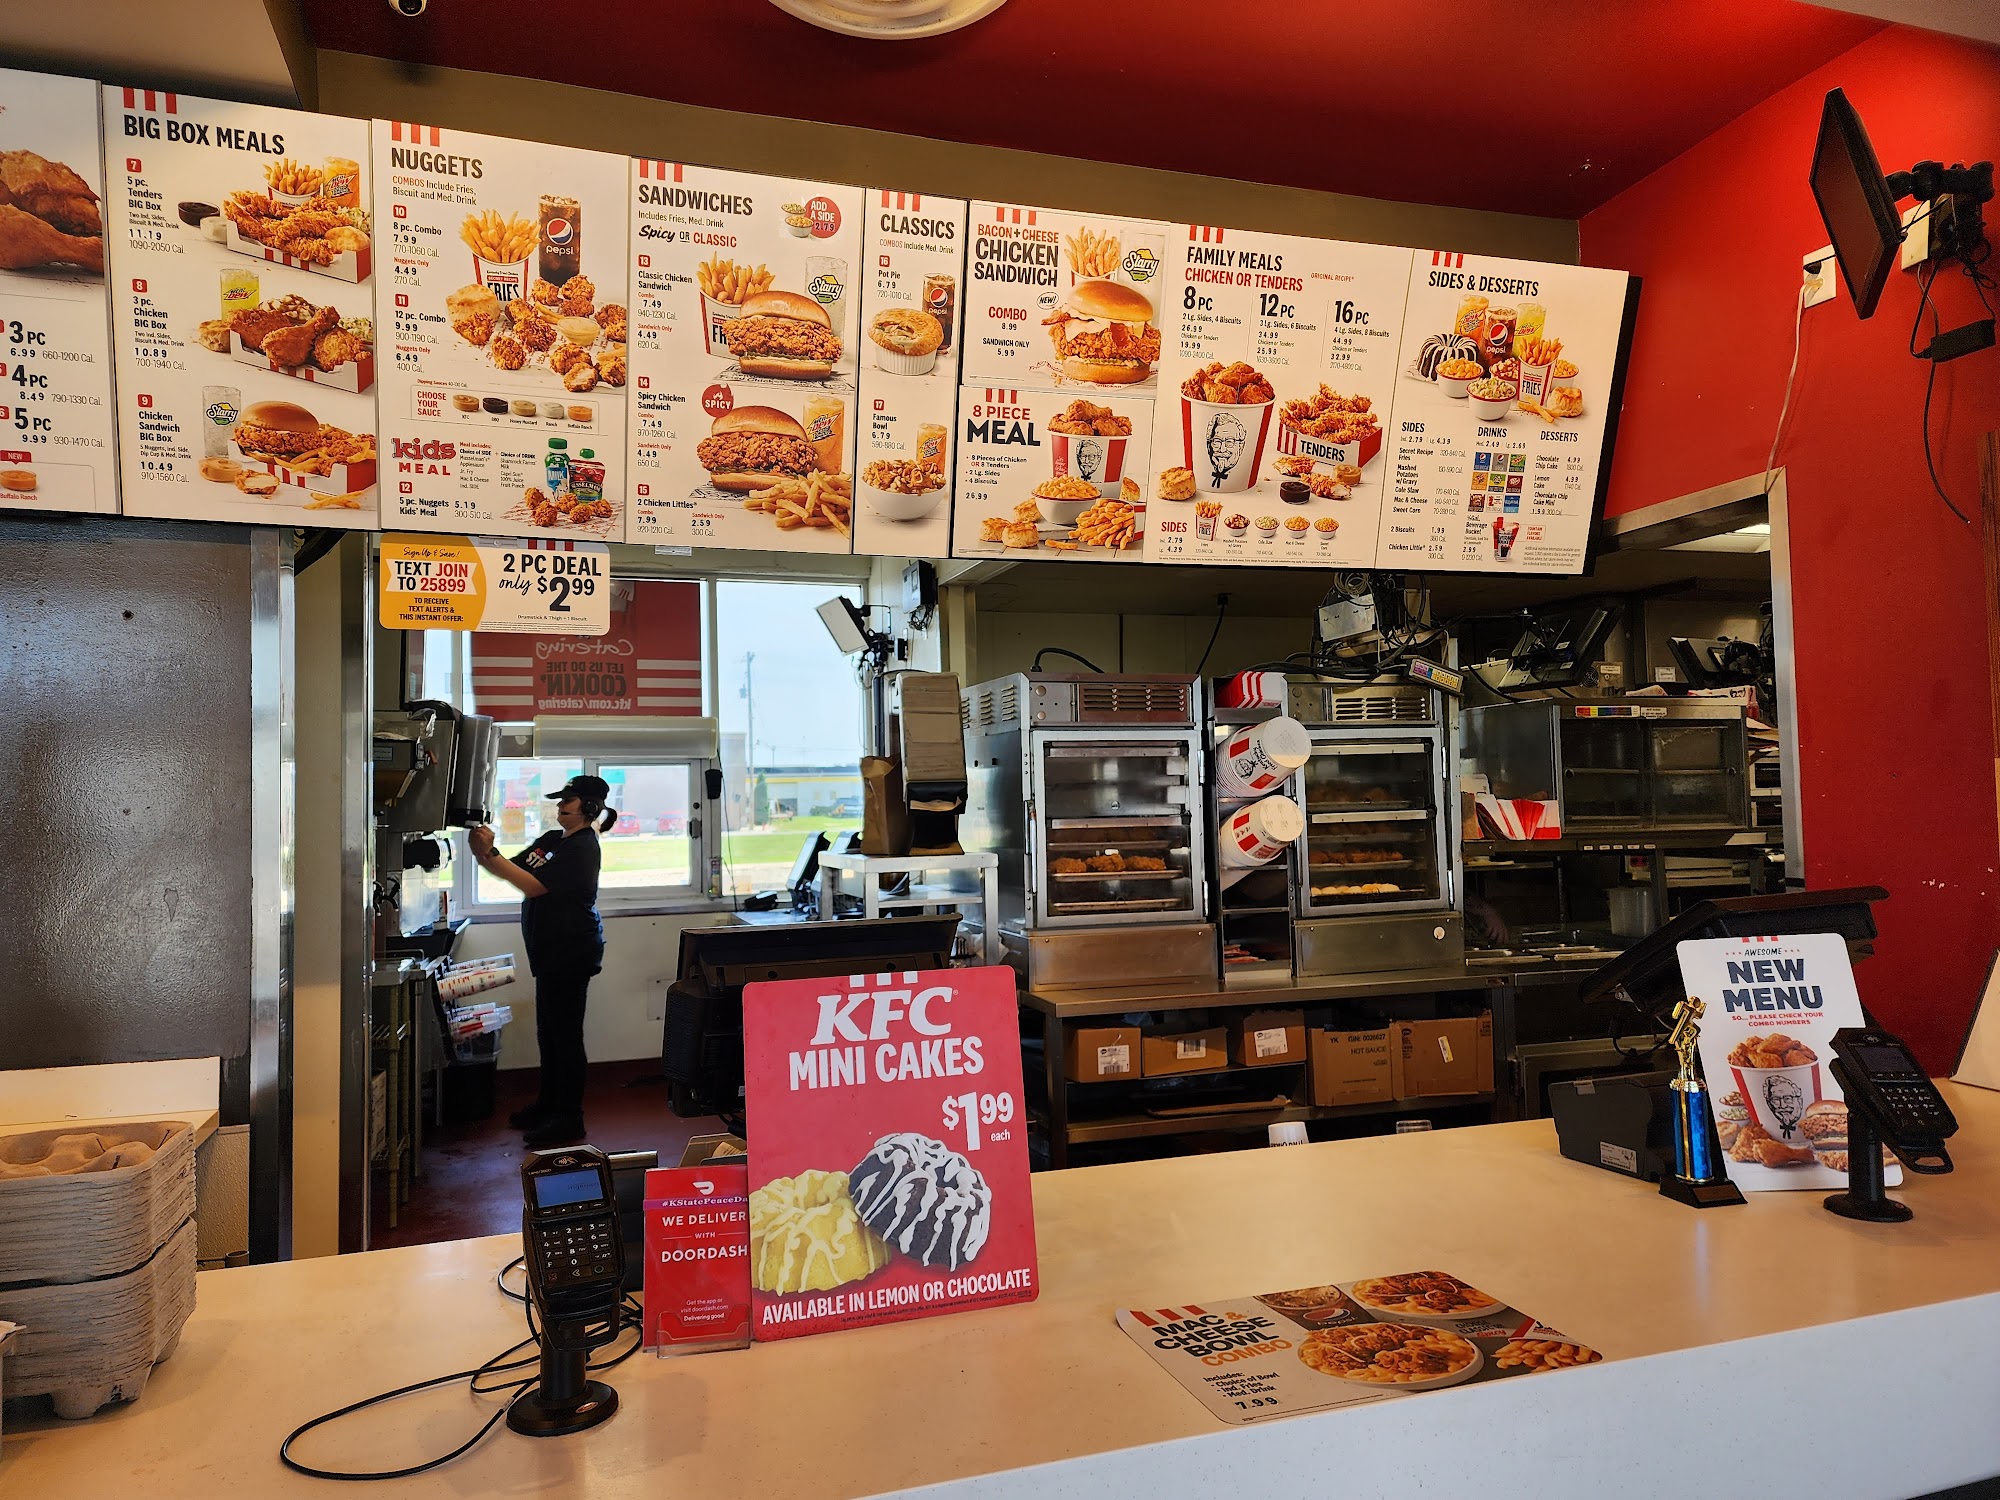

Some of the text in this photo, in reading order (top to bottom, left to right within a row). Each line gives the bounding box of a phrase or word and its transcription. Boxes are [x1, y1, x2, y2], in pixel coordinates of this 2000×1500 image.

[123, 114, 285, 155] BIG BOX MEALS
[391, 147, 483, 179] NUGGETS
[128, 176, 148, 188] 5 pc.
[392, 176, 476, 195] COMBOS Include Fries,
[128, 188, 163, 200] Tenders
[639, 184, 753, 216] SANDWICHES
[129, 200, 162, 211] BIG Box
[811, 201, 827, 212] ADD
[638, 211, 724, 228] Includes Fries, Med. Drink
[811, 211, 835, 223] A SIDE
[393, 222, 441, 235] 8 pc. Combo
[815, 223, 835, 231] 2.79
[880, 213, 954, 240] CLASSICS
[978, 224, 1012, 238] BACON
[1023, 229, 1059, 243] CHEESE
[129, 229, 162, 240] 11.19
[394, 234, 417, 244] 7.99
[639, 225, 737, 248] Spicy OR CLASSIC
[546, 245, 573, 256] pepsi
[976, 238, 1059, 267] CHICKEN
[1123, 253, 1160, 276] Starry
[1187, 246, 1282, 271] FAMILY MEALS
[638, 271, 693, 284] Classic Chicken
[878, 270, 900, 279] Pot Pie
[975, 262, 1057, 287] SANDWICH
[1185, 267, 1303, 291] CHICKEN OR TENDERS
[638, 281, 672, 291] Sandwich
[878, 281, 896, 289] 6.79
[1429, 270, 1539, 296] SIDES & DESSERTS
[644, 300, 661, 308] 7.49
[1039, 296, 1056, 305] NEW!
[1184, 286, 1213, 311] 8 PC
[1260, 293, 1295, 318] 12 PC
[988, 306, 1027, 321] COMBO
[1335, 300, 1369, 325] 16 PC
[9, 321, 46, 345] 3 PC
[983, 337, 1029, 348] SANDWICH ONLY
[10, 348, 36, 358] 6.99
[998, 348, 1015, 356] 5.99
[12, 365, 48, 388] 4 PC
[20, 391, 45, 401] 8.49
[417, 391, 446, 400] CHOOSE
[638, 392, 685, 402] Spicy Chicken
[417, 400, 437, 408] YOUR
[638, 401, 671, 411] Sandwich
[705, 399, 731, 409] SPICY
[15, 408, 51, 431] 5 PC
[417, 408, 441, 417] SAUCE
[873, 414, 897, 422] Famous
[973, 405, 1030, 420] 8 PIECE
[872, 422, 887, 430] Bowl
[967, 419, 1040, 446] MEAL
[1402, 422, 1425, 433] SIDES
[1478, 427, 1507, 437] DRINKS
[22, 434, 47, 444] 9.99
[1541, 431, 1578, 442] DESSERTS
[391, 438, 456, 460] kids
[1301, 440, 1345, 462] TENDERS
[399, 462, 450, 476] MEAL
[1161, 522, 1187, 533] SIDES
[395, 561, 468, 577] TEXT JOIN
[503, 554, 601, 576] 2 PC DEAL
[397, 577, 466, 592] TO 25899
[499, 574, 533, 595] only
[1745, 948, 1782, 956] AWESOME
[1727, 959, 1804, 984] NEW
[1722, 986, 1823, 1012] MENU
[810, 987, 953, 1046] KFC
[1365, 1046, 1386, 1054] SAUCE
[789, 1036, 984, 1091] MINI CAKES
[991, 1129, 1010, 1142] each
[662, 1211, 746, 1227] WE DELIVER
[661, 1245, 747, 1263] DOORDASH
[762, 1295, 847, 1325] AVAILABLE
[849, 1293, 866, 1311] IN
[868, 1285, 921, 1309] LEMON
[924, 1282, 944, 1302] OR
[947, 1268, 1031, 1299] CHOCOLATE
[684, 1314, 708, 1322] Delivering
[1152, 1312, 1247, 1337] MAC &
[1154, 1316, 1275, 1349] CHEESE
[1183, 1331, 1279, 1357] BOWL
[1201, 1339, 1292, 1366] COMBO
